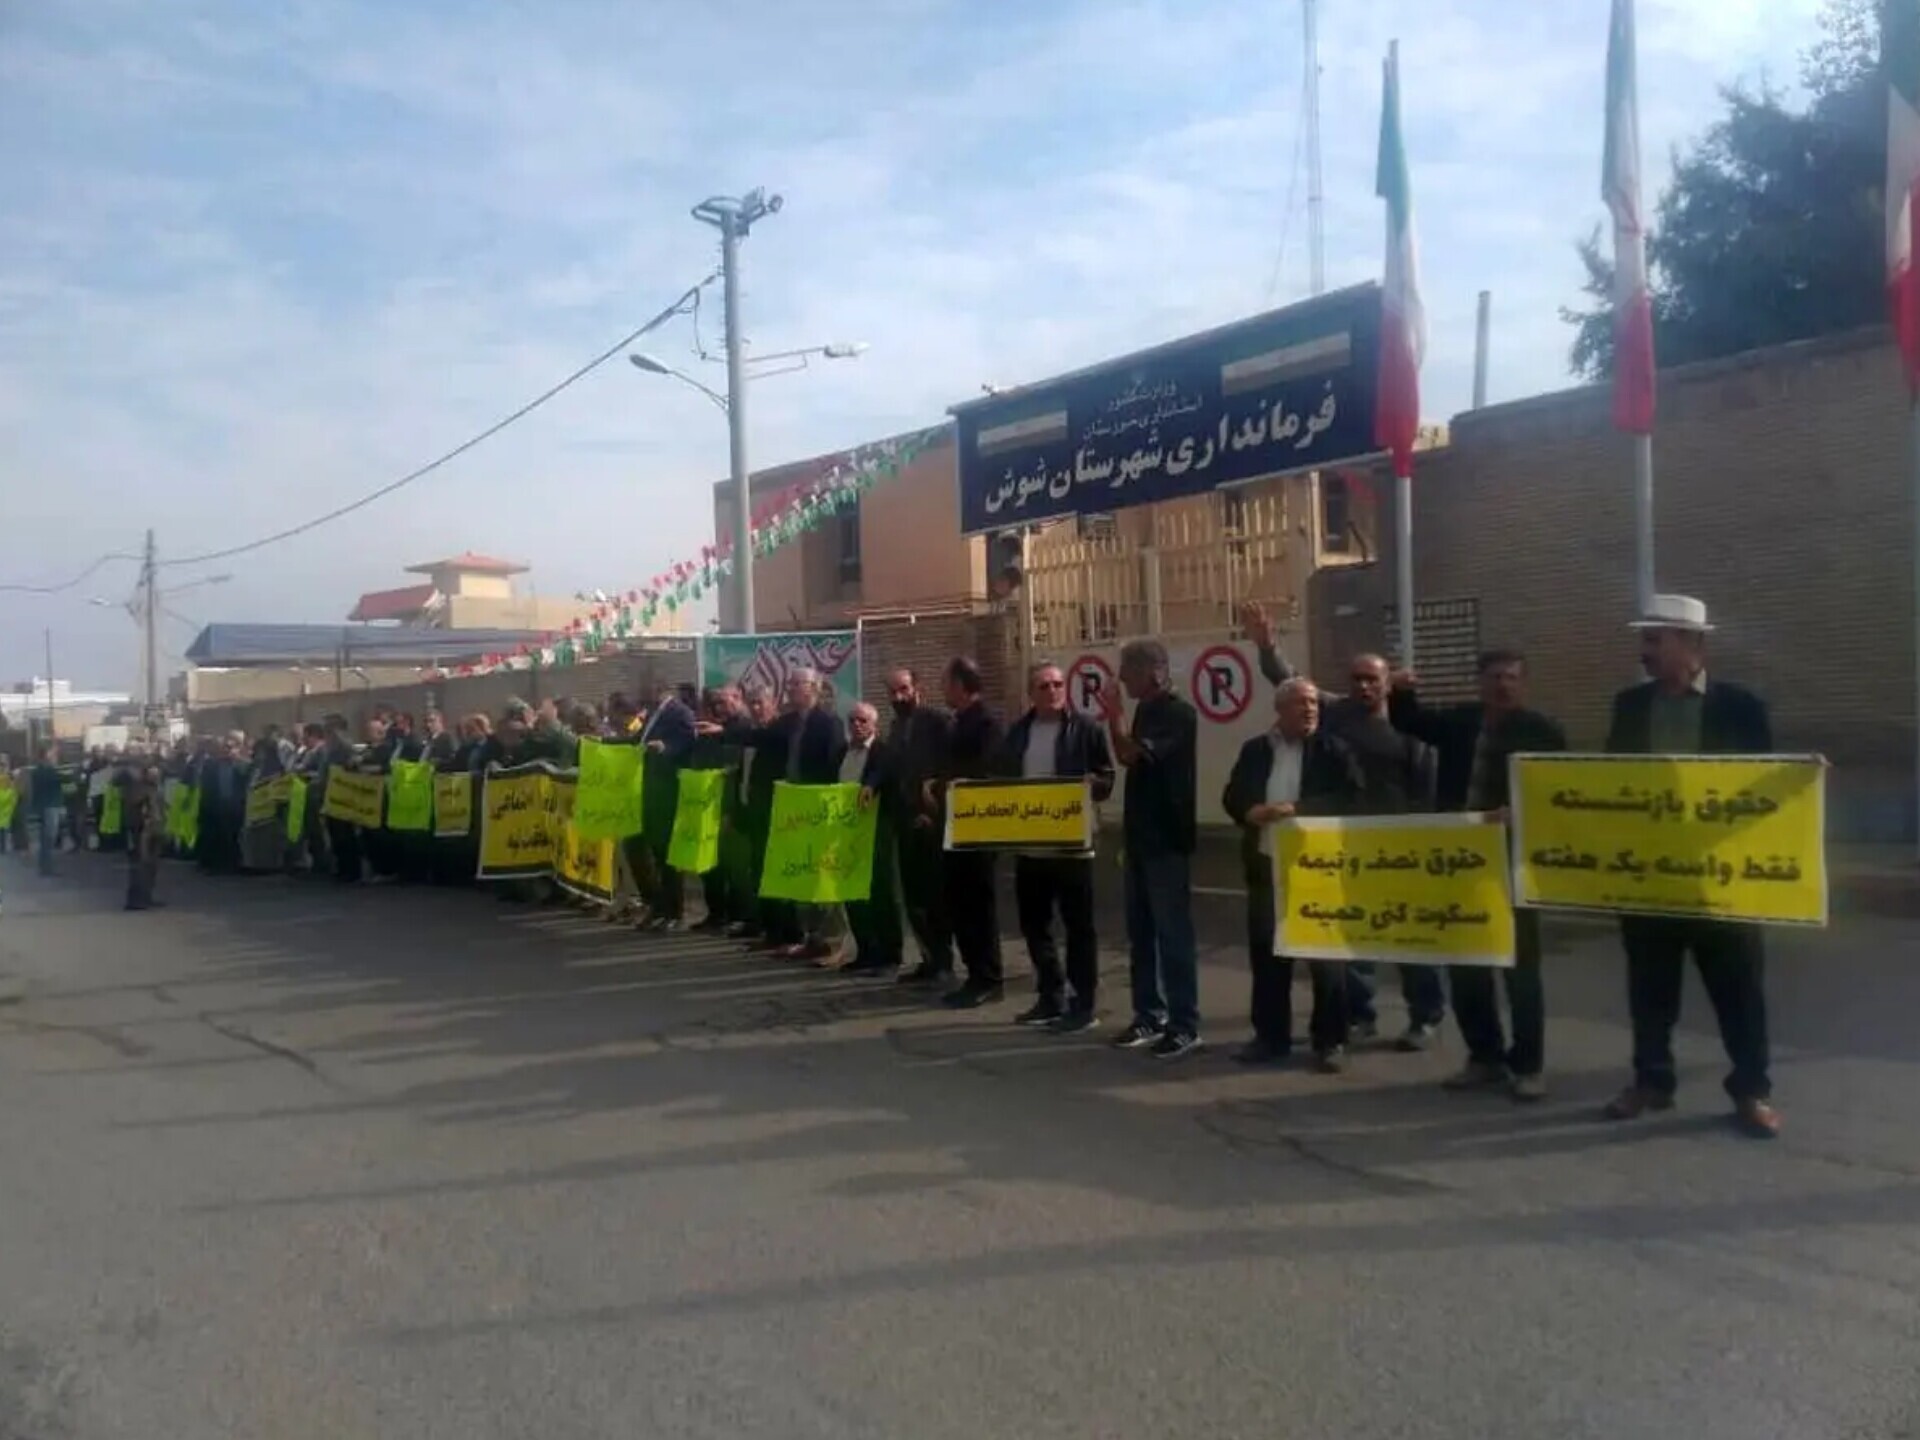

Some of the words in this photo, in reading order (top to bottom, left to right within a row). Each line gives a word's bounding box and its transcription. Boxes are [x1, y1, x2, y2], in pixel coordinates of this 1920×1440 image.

[1167, 379, 1336, 475] فرمانداری
[1049, 427, 1163, 499] شهرستان
[985, 456, 1047, 513] شوش
[1552, 784, 1685, 822] بازنشسته
[1695, 788, 1778, 826] حقوق
[1298, 850, 1343, 876] نیمه
[1365, 849, 1418, 870] نصف
[1426, 848, 1486, 876] حقوق
[1530, 845, 1597, 870] هفته
[1606, 850, 1646, 882] یک
[1655, 854, 1733, 886] واسه
[1742, 855, 1800, 881] فقط
[1299, 902, 1365, 926] همینه
[1370, 898, 1407, 929] کنی
[1415, 902, 1490, 930] سکوت
